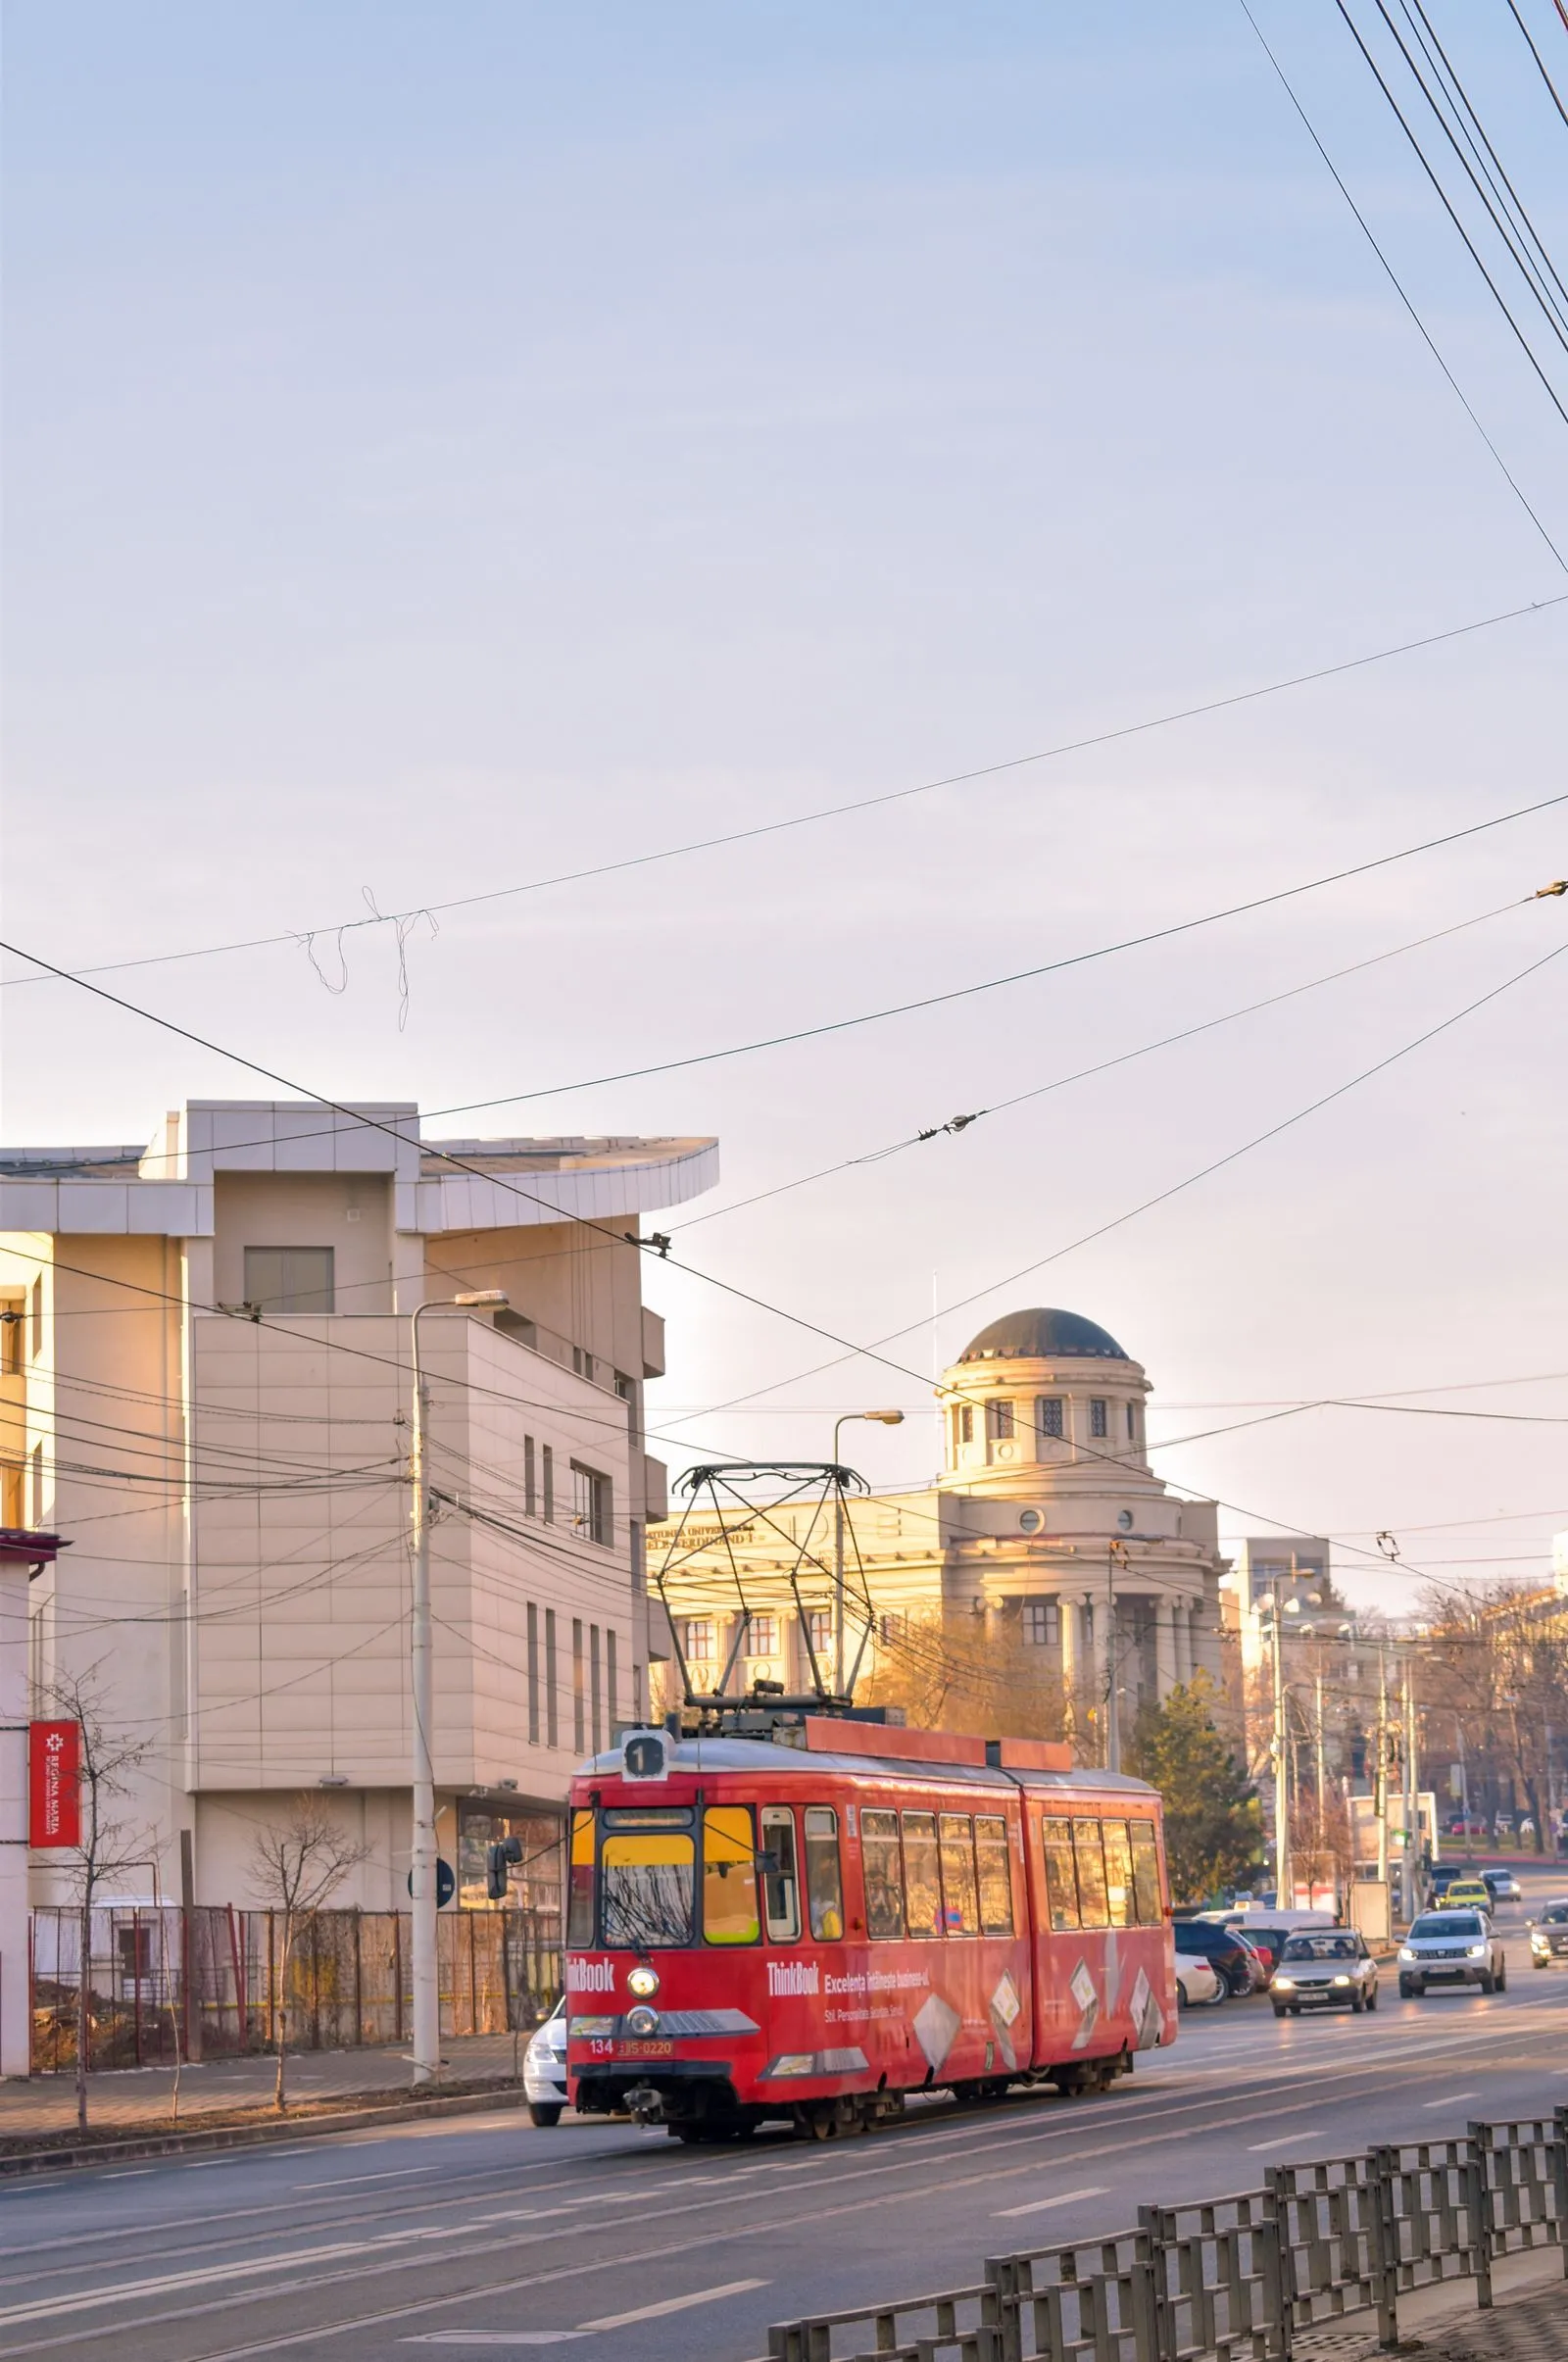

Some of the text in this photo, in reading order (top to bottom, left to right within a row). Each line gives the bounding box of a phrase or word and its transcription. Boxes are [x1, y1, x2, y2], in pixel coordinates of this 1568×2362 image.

[632, 1746, 644, 1771] 1
[767, 1961, 819, 1995] ThinkBook
[590, 2039, 613, 2054] 134
